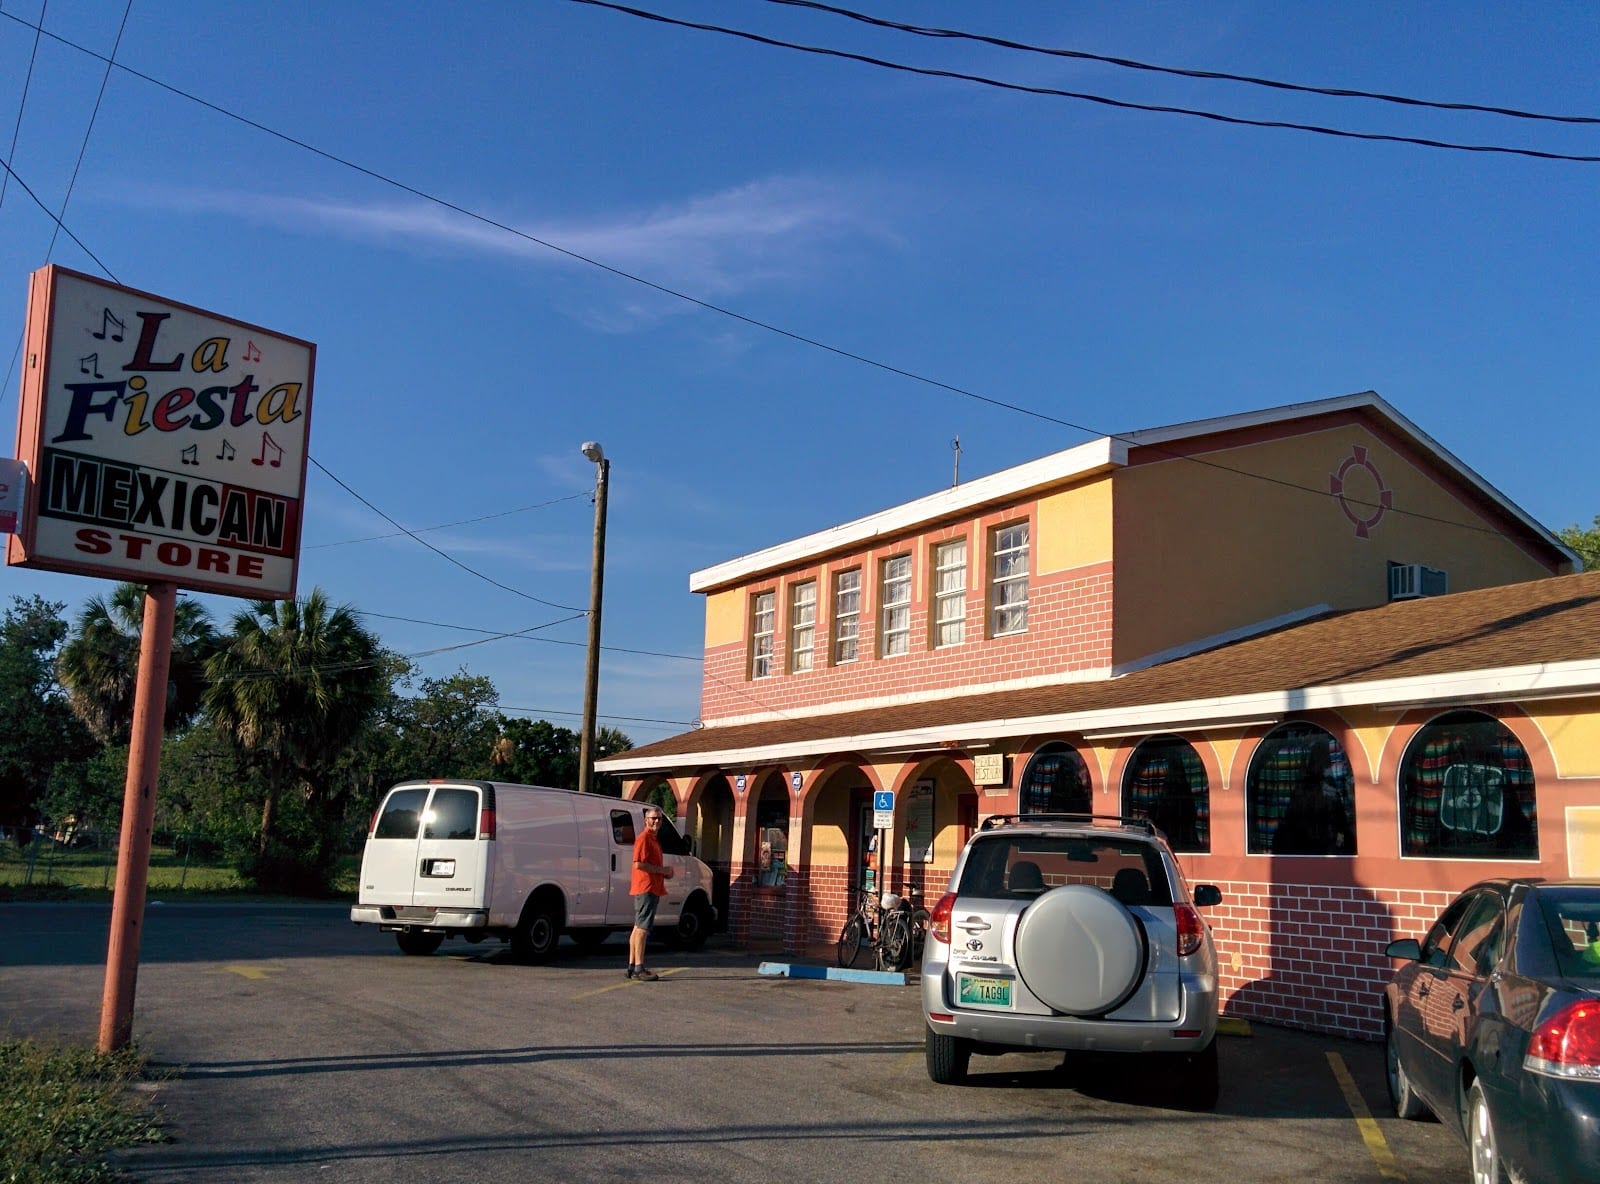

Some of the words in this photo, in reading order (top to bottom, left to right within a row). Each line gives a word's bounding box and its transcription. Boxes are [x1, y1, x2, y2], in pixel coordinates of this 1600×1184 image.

[122, 311, 231, 374] La
[52, 374, 303, 444] Fiesta
[49, 454, 288, 550] MEXICAN
[74, 528, 265, 579] STORE
